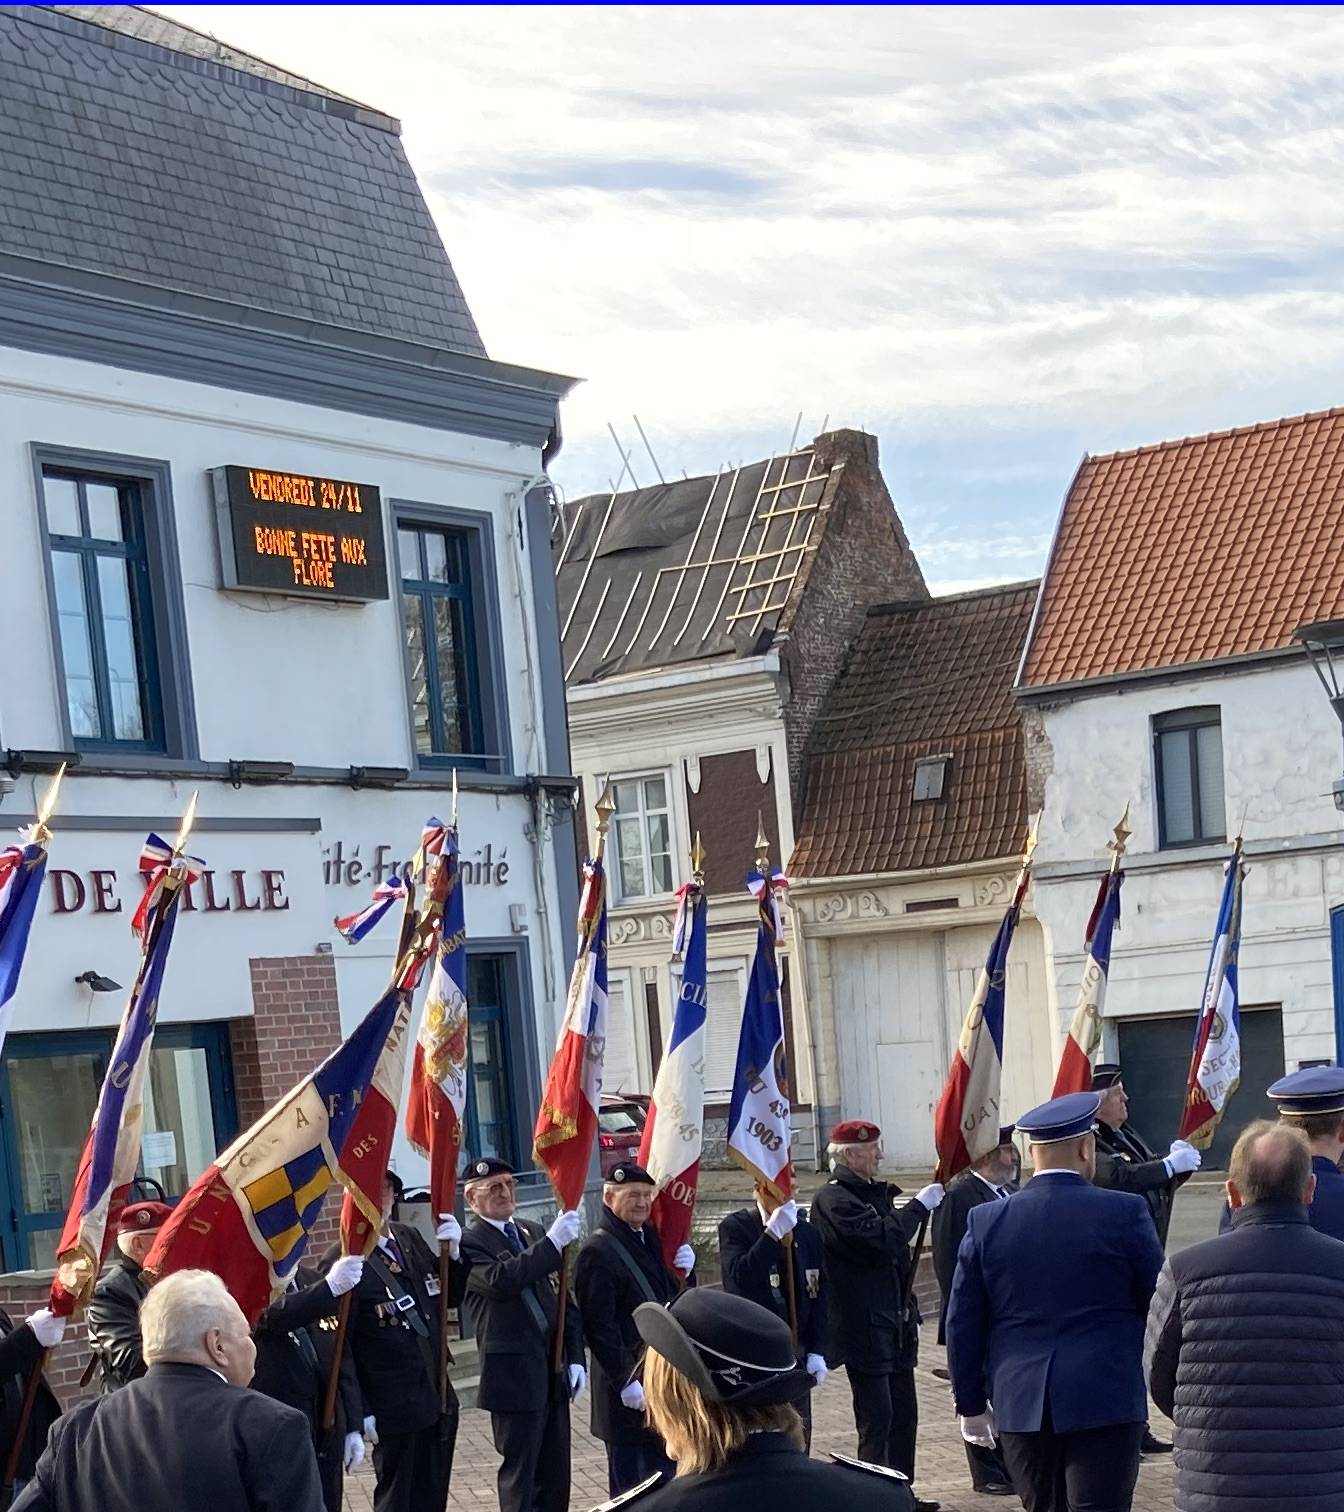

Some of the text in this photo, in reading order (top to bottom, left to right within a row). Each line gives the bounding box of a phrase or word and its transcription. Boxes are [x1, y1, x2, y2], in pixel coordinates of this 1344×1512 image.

[249, 471, 362, 513] VENDREDI 24/11
[255, 526, 367, 566] BONNE FETE AUX
[292, 558, 335, 588] FLORE
[49, 869, 122, 914] DE
[139, 869, 290, 913] ILLE
[353, 1133, 378, 1160] DES
[746, 1116, 784, 1152] 1903
